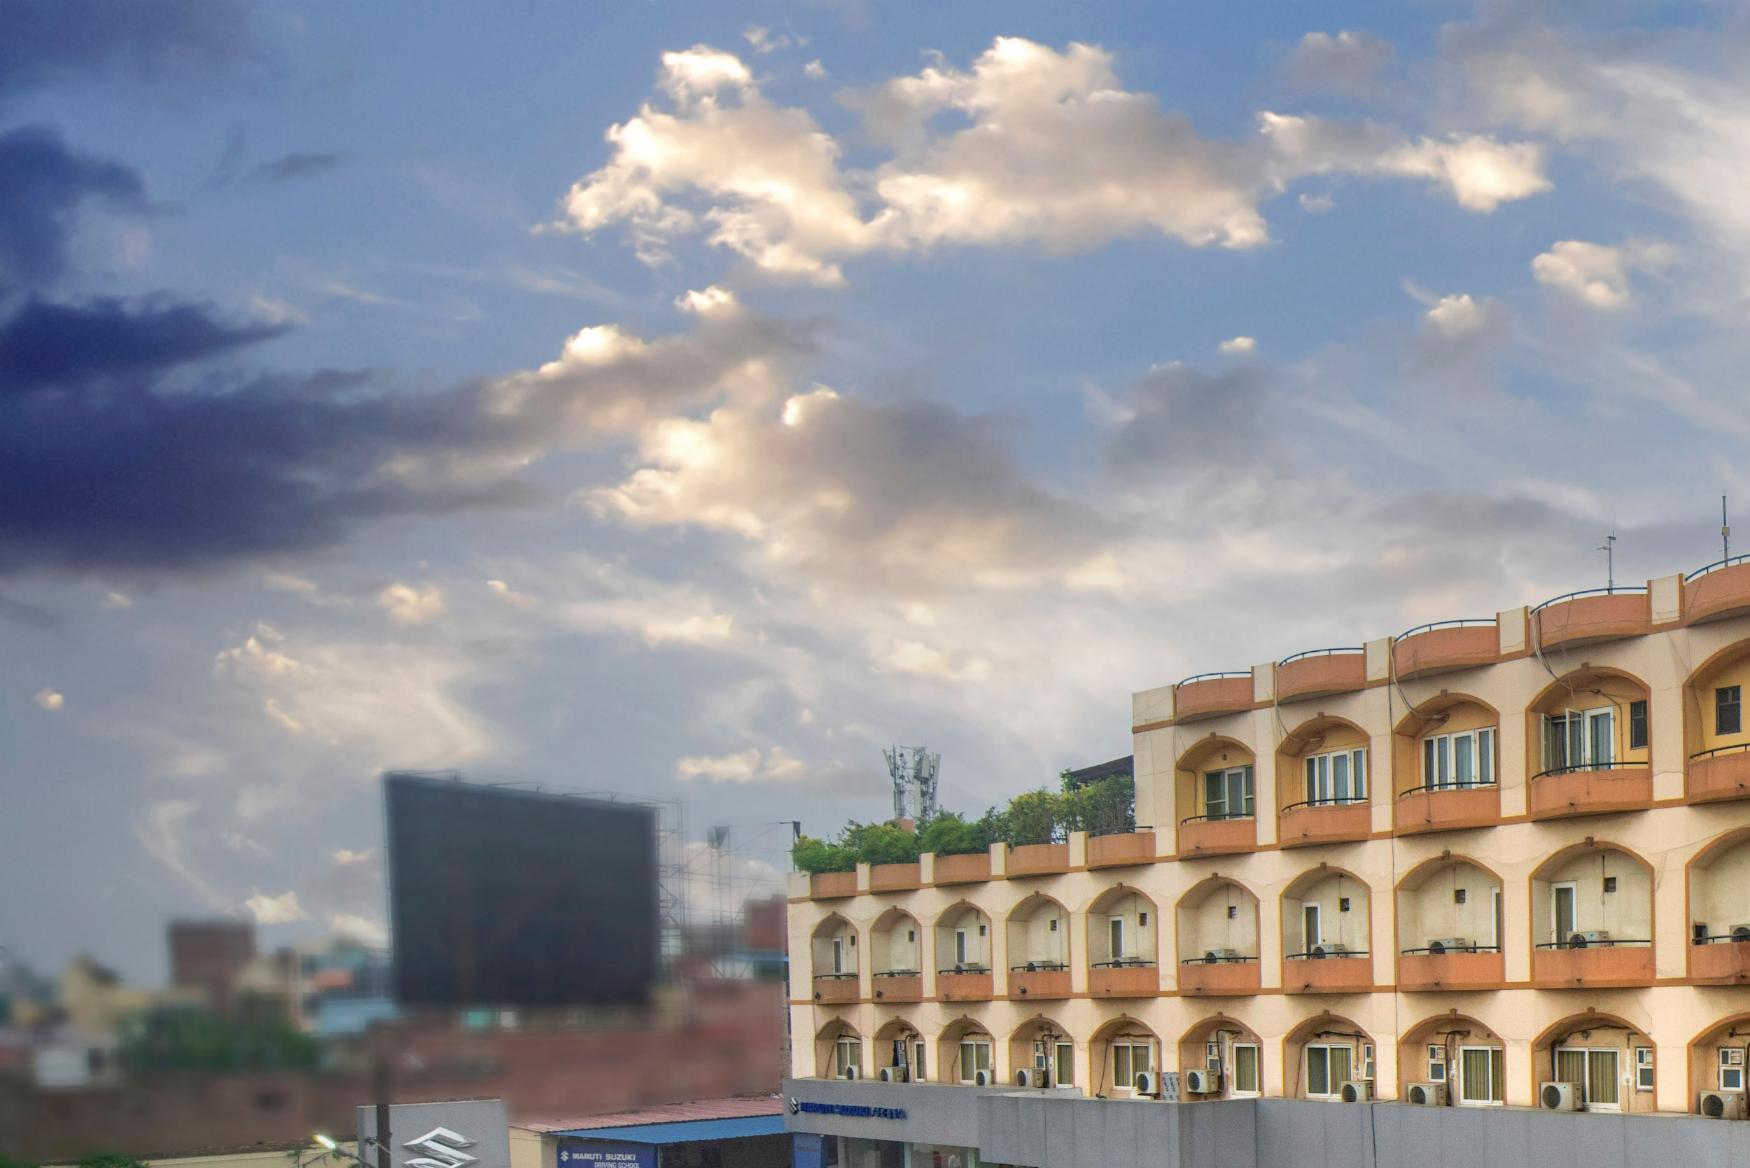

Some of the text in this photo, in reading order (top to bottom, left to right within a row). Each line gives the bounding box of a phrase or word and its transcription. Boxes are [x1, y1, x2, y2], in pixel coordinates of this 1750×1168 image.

[572, 1152, 636, 1161] MARUTI SUZUKI
[594, 1161, 617, 1168] DRIVING
